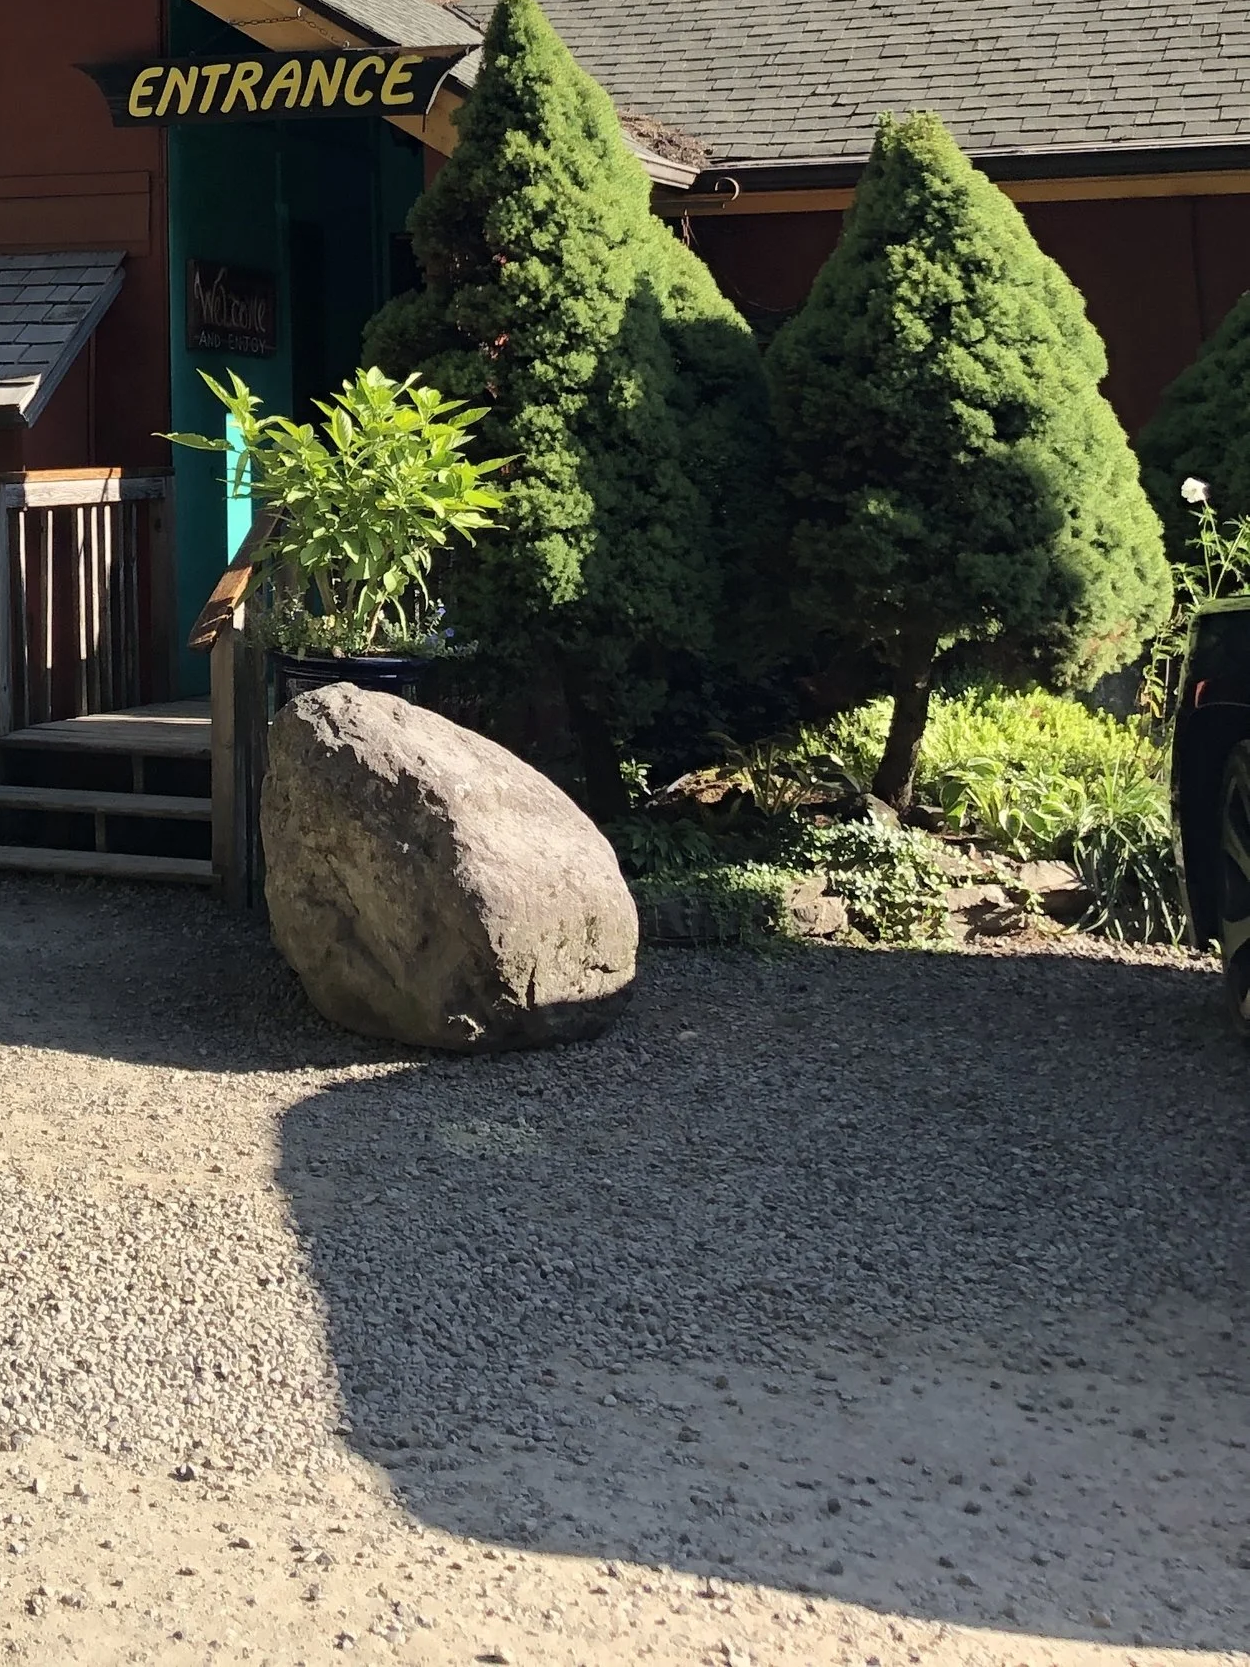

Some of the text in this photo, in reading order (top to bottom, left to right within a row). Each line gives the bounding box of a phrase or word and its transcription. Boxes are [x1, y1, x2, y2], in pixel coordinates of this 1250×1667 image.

[128, 55, 424, 118] ENTRANCE
[198, 330, 266, 353] AND ENJOY
